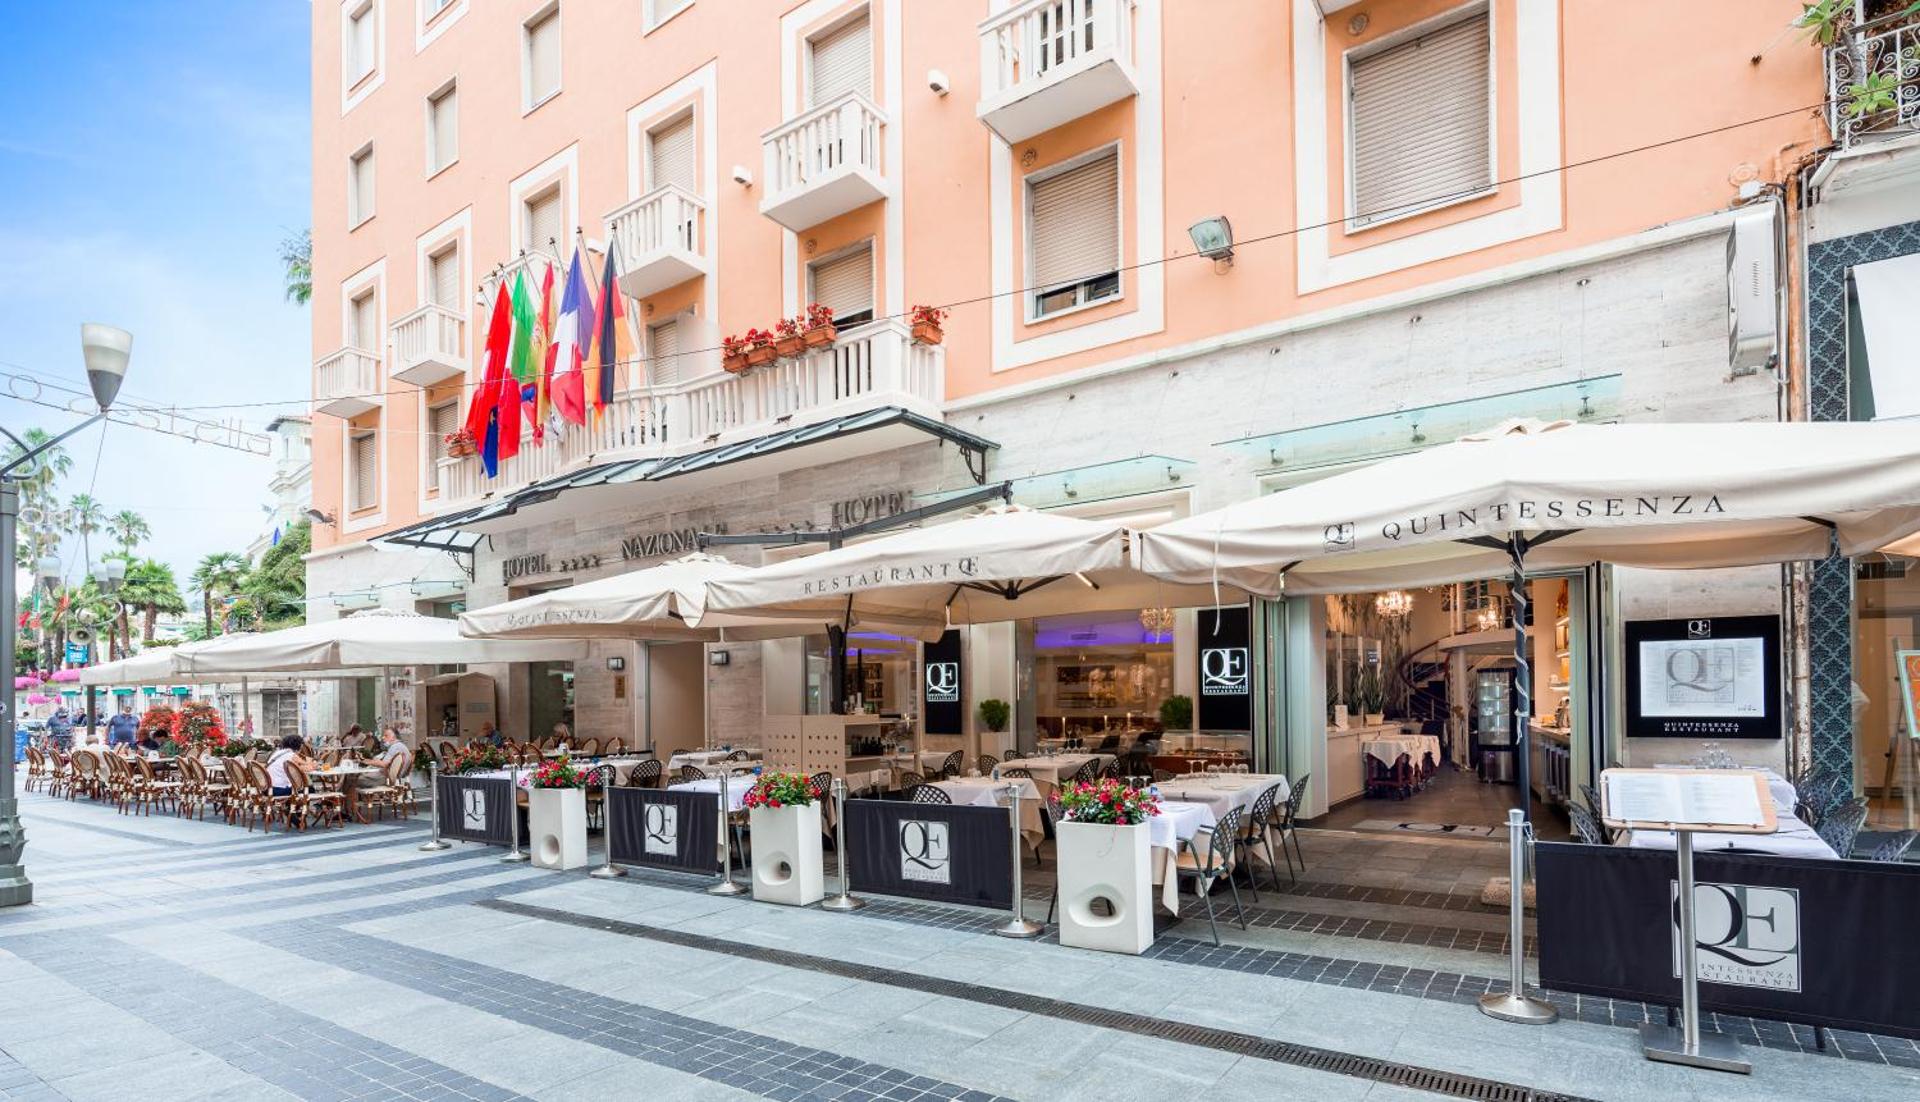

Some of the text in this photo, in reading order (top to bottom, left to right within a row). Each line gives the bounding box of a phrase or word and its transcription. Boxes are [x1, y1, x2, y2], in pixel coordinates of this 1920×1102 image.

[1382, 494, 1726, 541] QUINTESSENZA
[804, 563, 950, 595] RESTAURANT
[1700, 962, 1793, 980] INTESSENZA
[1702, 970, 1794, 988] STAURANT
